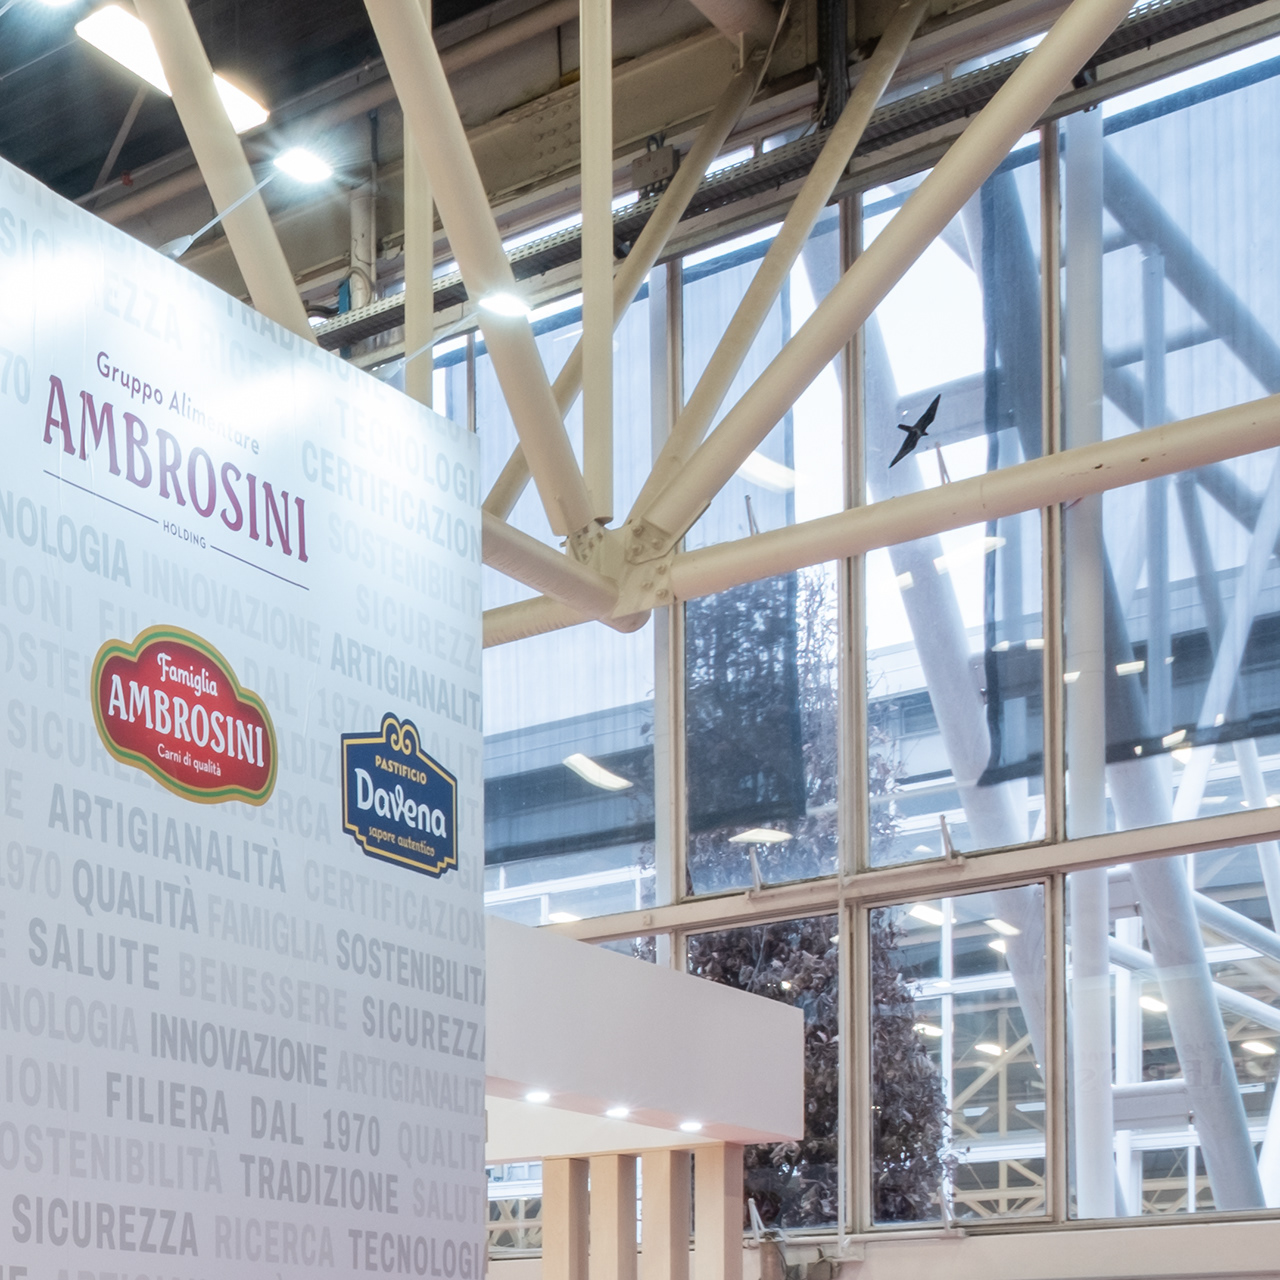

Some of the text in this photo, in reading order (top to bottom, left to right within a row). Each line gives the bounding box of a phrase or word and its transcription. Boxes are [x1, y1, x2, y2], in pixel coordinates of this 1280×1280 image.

[97, 351, 164, 405] Gruppo
[169, 390, 260, 455] Alimentare
[43, 374, 309, 563] AMBROSINI
[334, 392, 481, 512] TECNOLOGI
[163, 520, 207, 549] HOLDING
[142, 549, 321, 667] INNOVAZIONE
[329, 628, 483, 733] ARTIGIANALIT
[157, 652, 218, 697] Famiglia
[355, 580, 482, 678] SICUREZZ
[108, 674, 264, 768] AMBROSINI
[242, 653, 375, 747] DAL 1970
[157, 743, 222, 777] Carni di qualità
[354, 768, 447, 838] Davena
[375, 755, 427, 785] PASTIFICIO
[47, 768, 287, 895] ARTIGIANALITÀ
[369, 826, 395, 843] sapore
[71, 843, 199, 939] QUALITÀ
[207, 893, 328, 968] FAMIGLIA
[27, 915, 160, 993] SALUTE
[178, 951, 347, 1033] BENESSERE
[361, 994, 485, 1063] SICUREZZ
[150, 1010, 327, 1088] INNOVAZIONE
[335, 1048, 485, 1118] ARTIGIANALIT
[105, 1070, 230, 1136] FILIERA
[250, 1094, 304, 1146] DAL
[322, 1106, 380, 1157] 1970
[397, 1120, 485, 1178] QUALIT
[10, 1193, 199, 1258] SICUREZZA
[215, 1214, 335, 1269] RICERCA
[239, 1153, 398, 1216] TRADIZIONE
